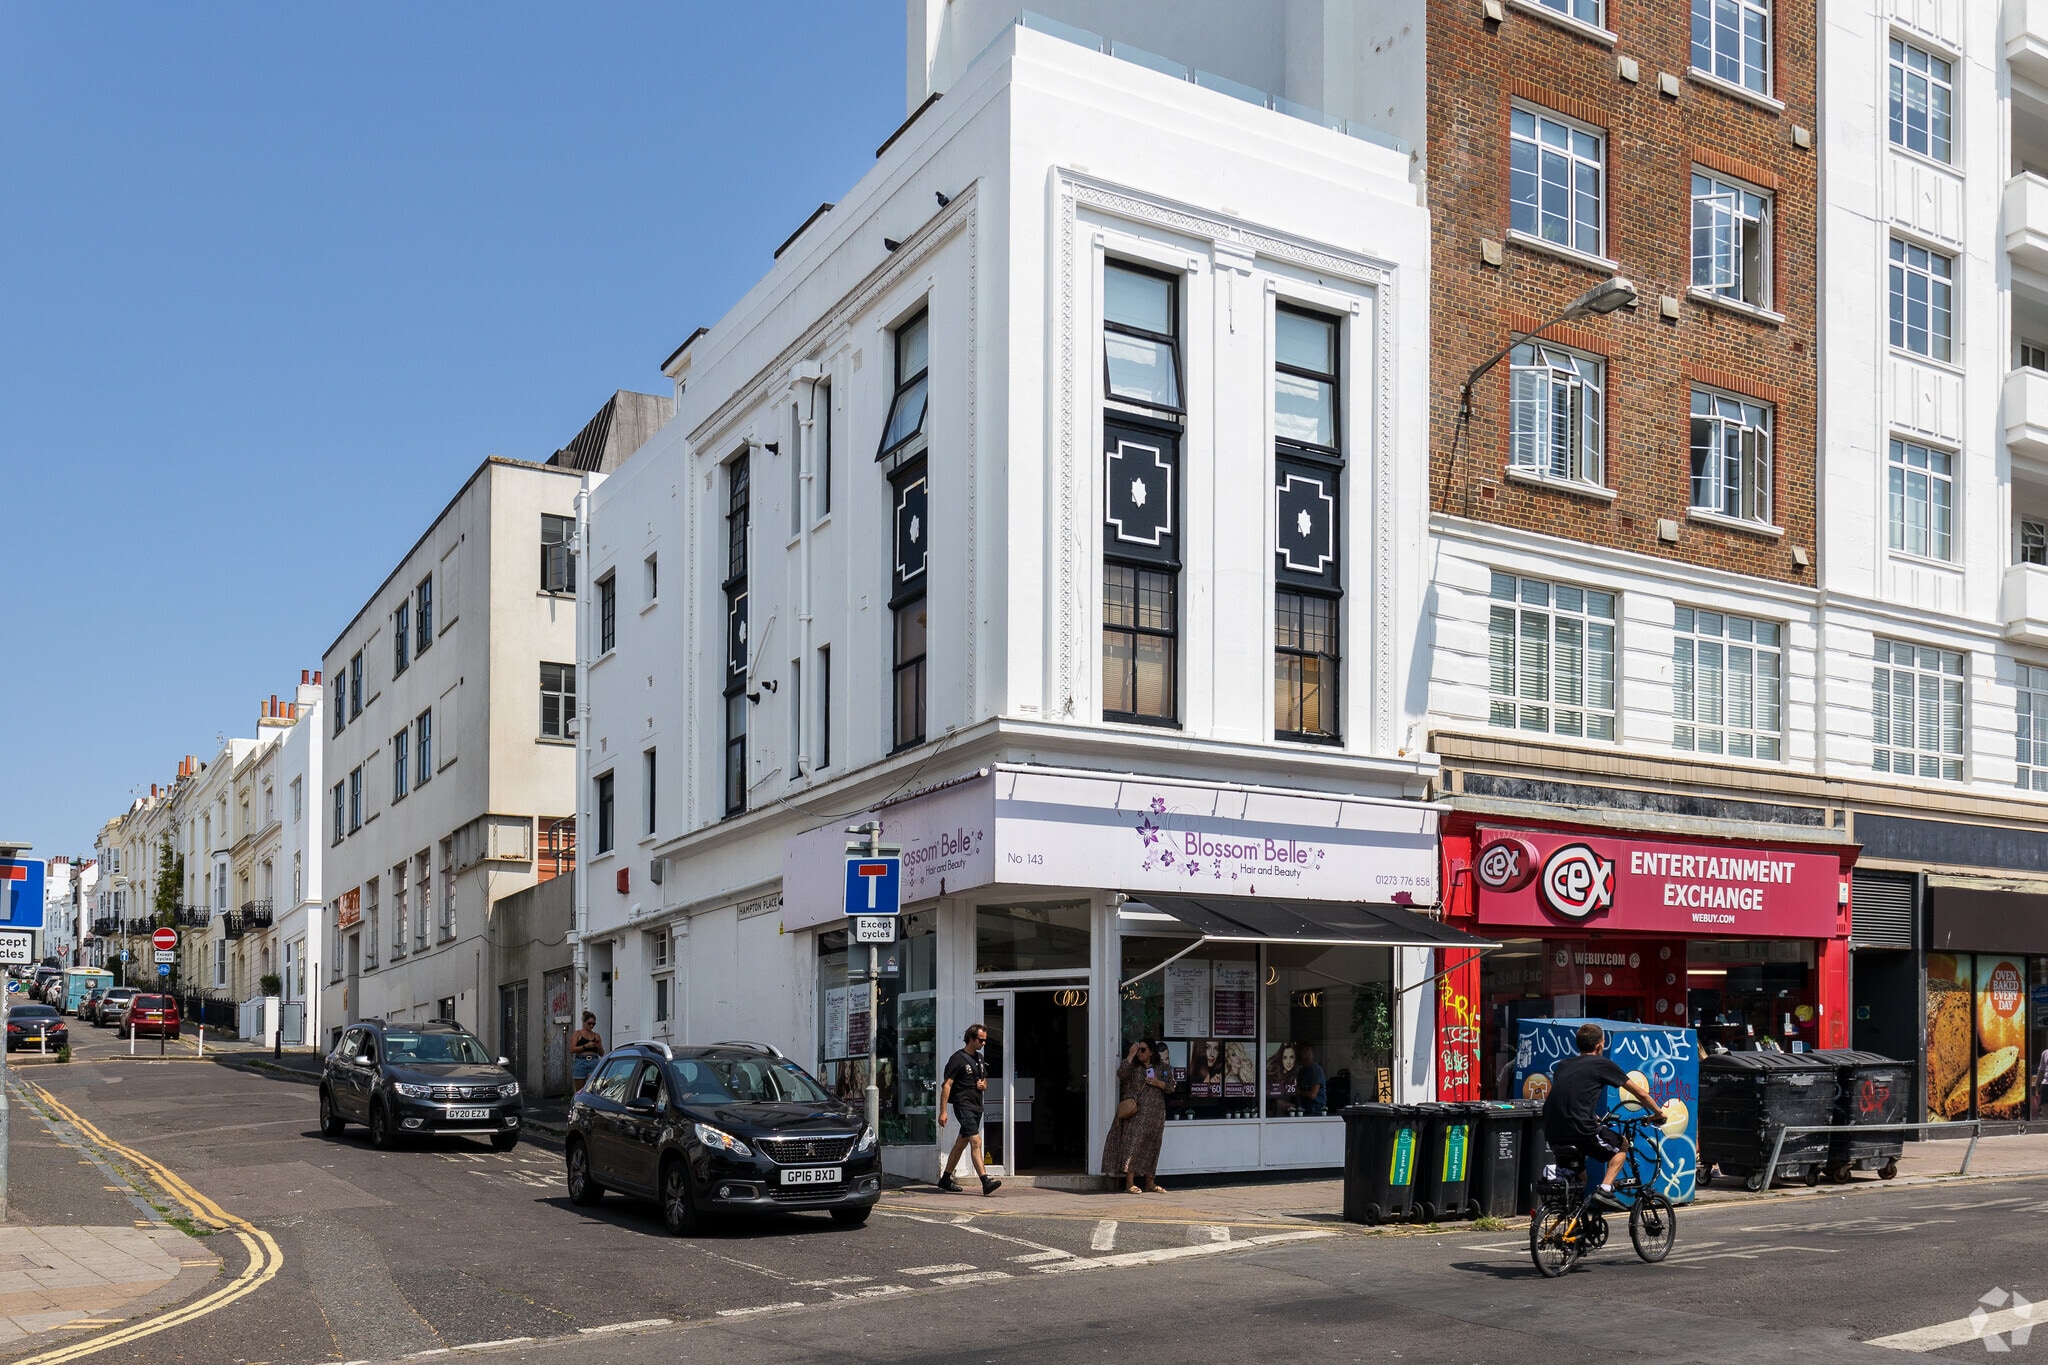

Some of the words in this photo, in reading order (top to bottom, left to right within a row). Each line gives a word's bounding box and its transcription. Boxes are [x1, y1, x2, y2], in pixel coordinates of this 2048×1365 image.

[903, 844, 938, 867] ossom
[941, 827, 971, 857] Belle
[1185, 831, 1258, 860] Blossom
[1264, 838, 1308, 864] Belle
[1007, 852, 1023, 864] No
[1027, 853, 1044, 865] 143
[925, 864, 936, 876] Hair
[936, 860, 947, 874] and
[947, 858, 967, 871] Beauty
[1240, 863, 1257, 874] Hair
[1257, 865, 1273, 876] and
[1274, 866, 1302, 879] Beauty
[1630, 851, 1796, 884] ENTERTAINMENT
[1375, 874, 1398, 885] 01273
[1400, 876, 1414, 886] 776
[1415, 877, 1431, 887] 858
[1663, 883, 1764, 911] EXCHANGE
[739, 903, 762, 915] HAMPTON
[763, 897, 778, 909] PLACE
[861, 920, 892, 929] Except
[1692, 913, 1735, 924] WEBUY.COM
[862, 930, 890, 939] cycles
[0, 938, 27, 948] cept
[0, 949, 25, 959] cles
[1574, 952, 1626, 966] WEBUY.COM
[1995, 970, 2017, 981] OVEN
[1992, 980, 2019, 991] BAKED
[1993, 991, 2018, 1001] EVERY
[1998, 1000, 2014, 1011] DAY
[1379, 1069, 1391, 1103] 日本
[449, 1110, 470, 1118] GY20
[471, 1110, 487, 1118] EZX
[787, 1170, 812, 1182] GP16
[814, 1169, 836, 1181] BXD
